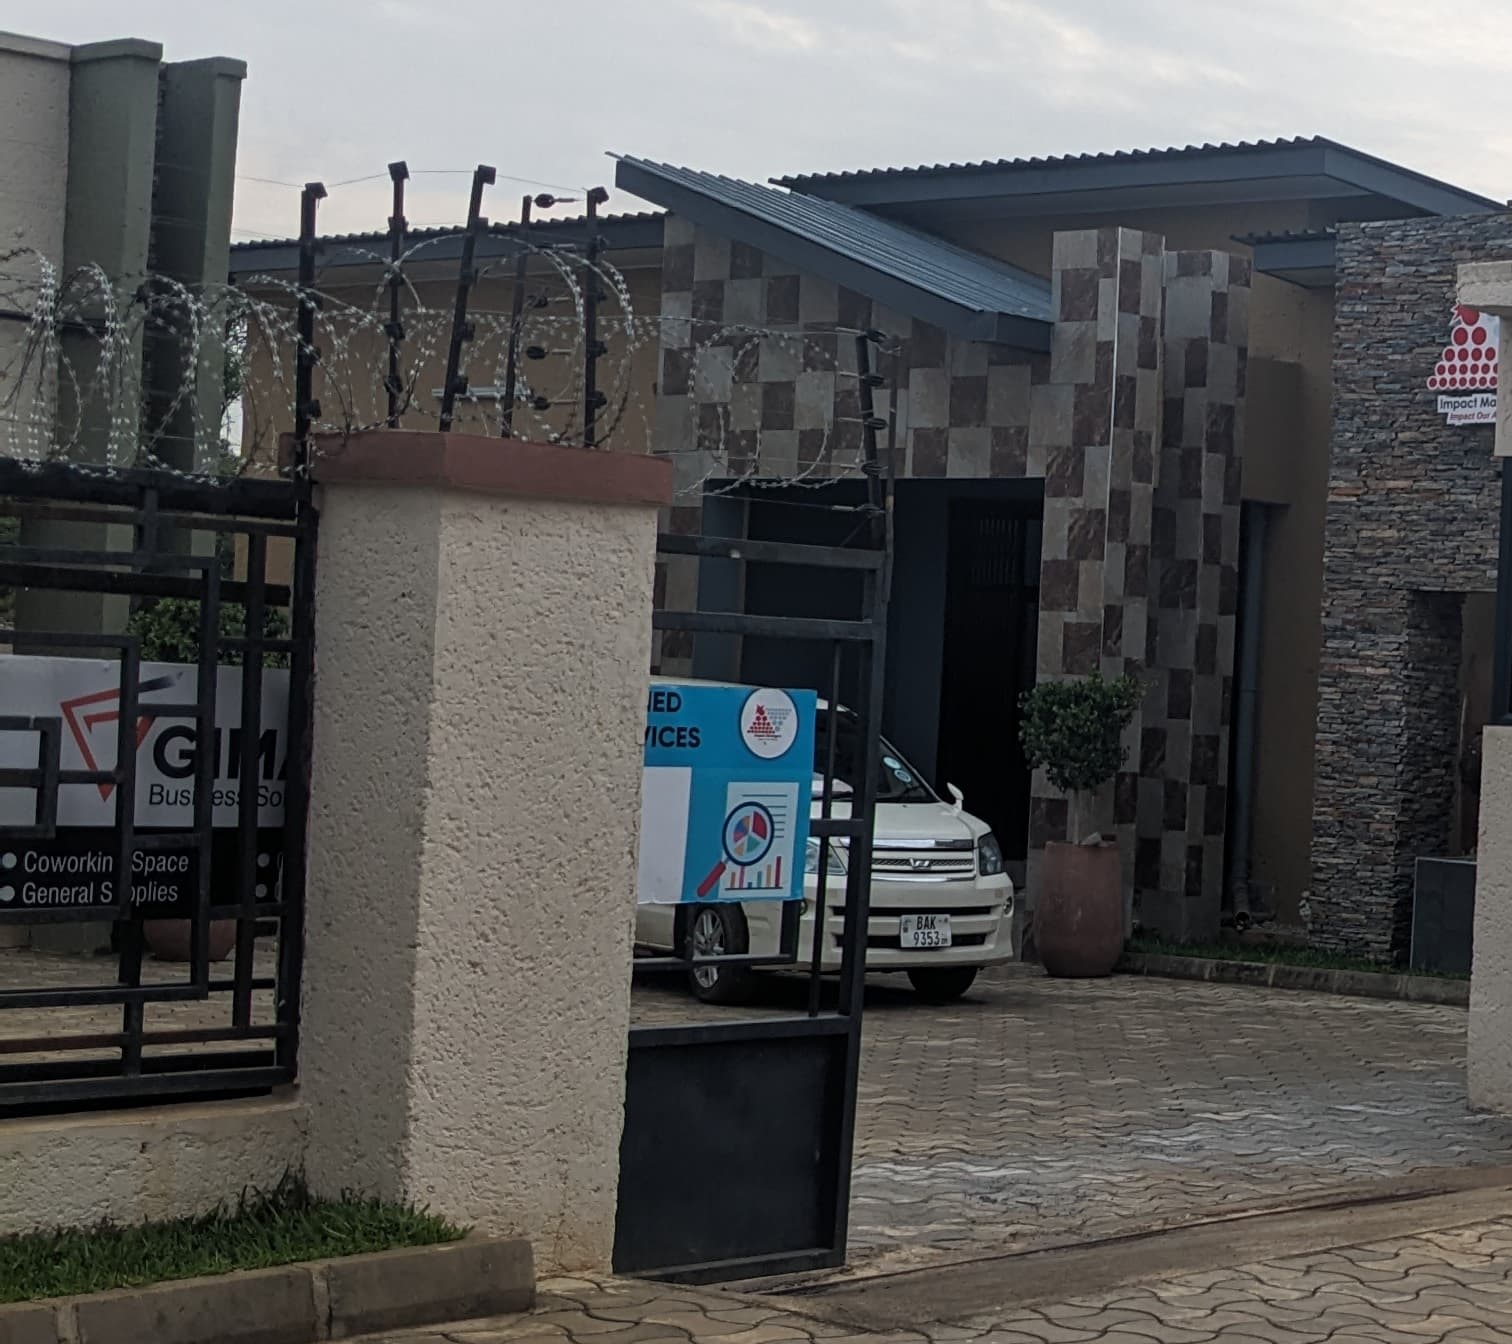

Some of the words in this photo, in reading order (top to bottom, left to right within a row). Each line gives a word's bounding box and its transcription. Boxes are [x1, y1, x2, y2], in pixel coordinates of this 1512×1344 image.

[1440, 397, 1477, 411] Impact
[256, 786, 287, 808] So
[23, 850, 117, 873] Coworkin
[130, 850, 189, 878] Space
[22, 881, 94, 905] General
[100, 880, 179, 907] Splies
[917, 915, 936, 930] BAK
[913, 930, 940, 946] 9353
